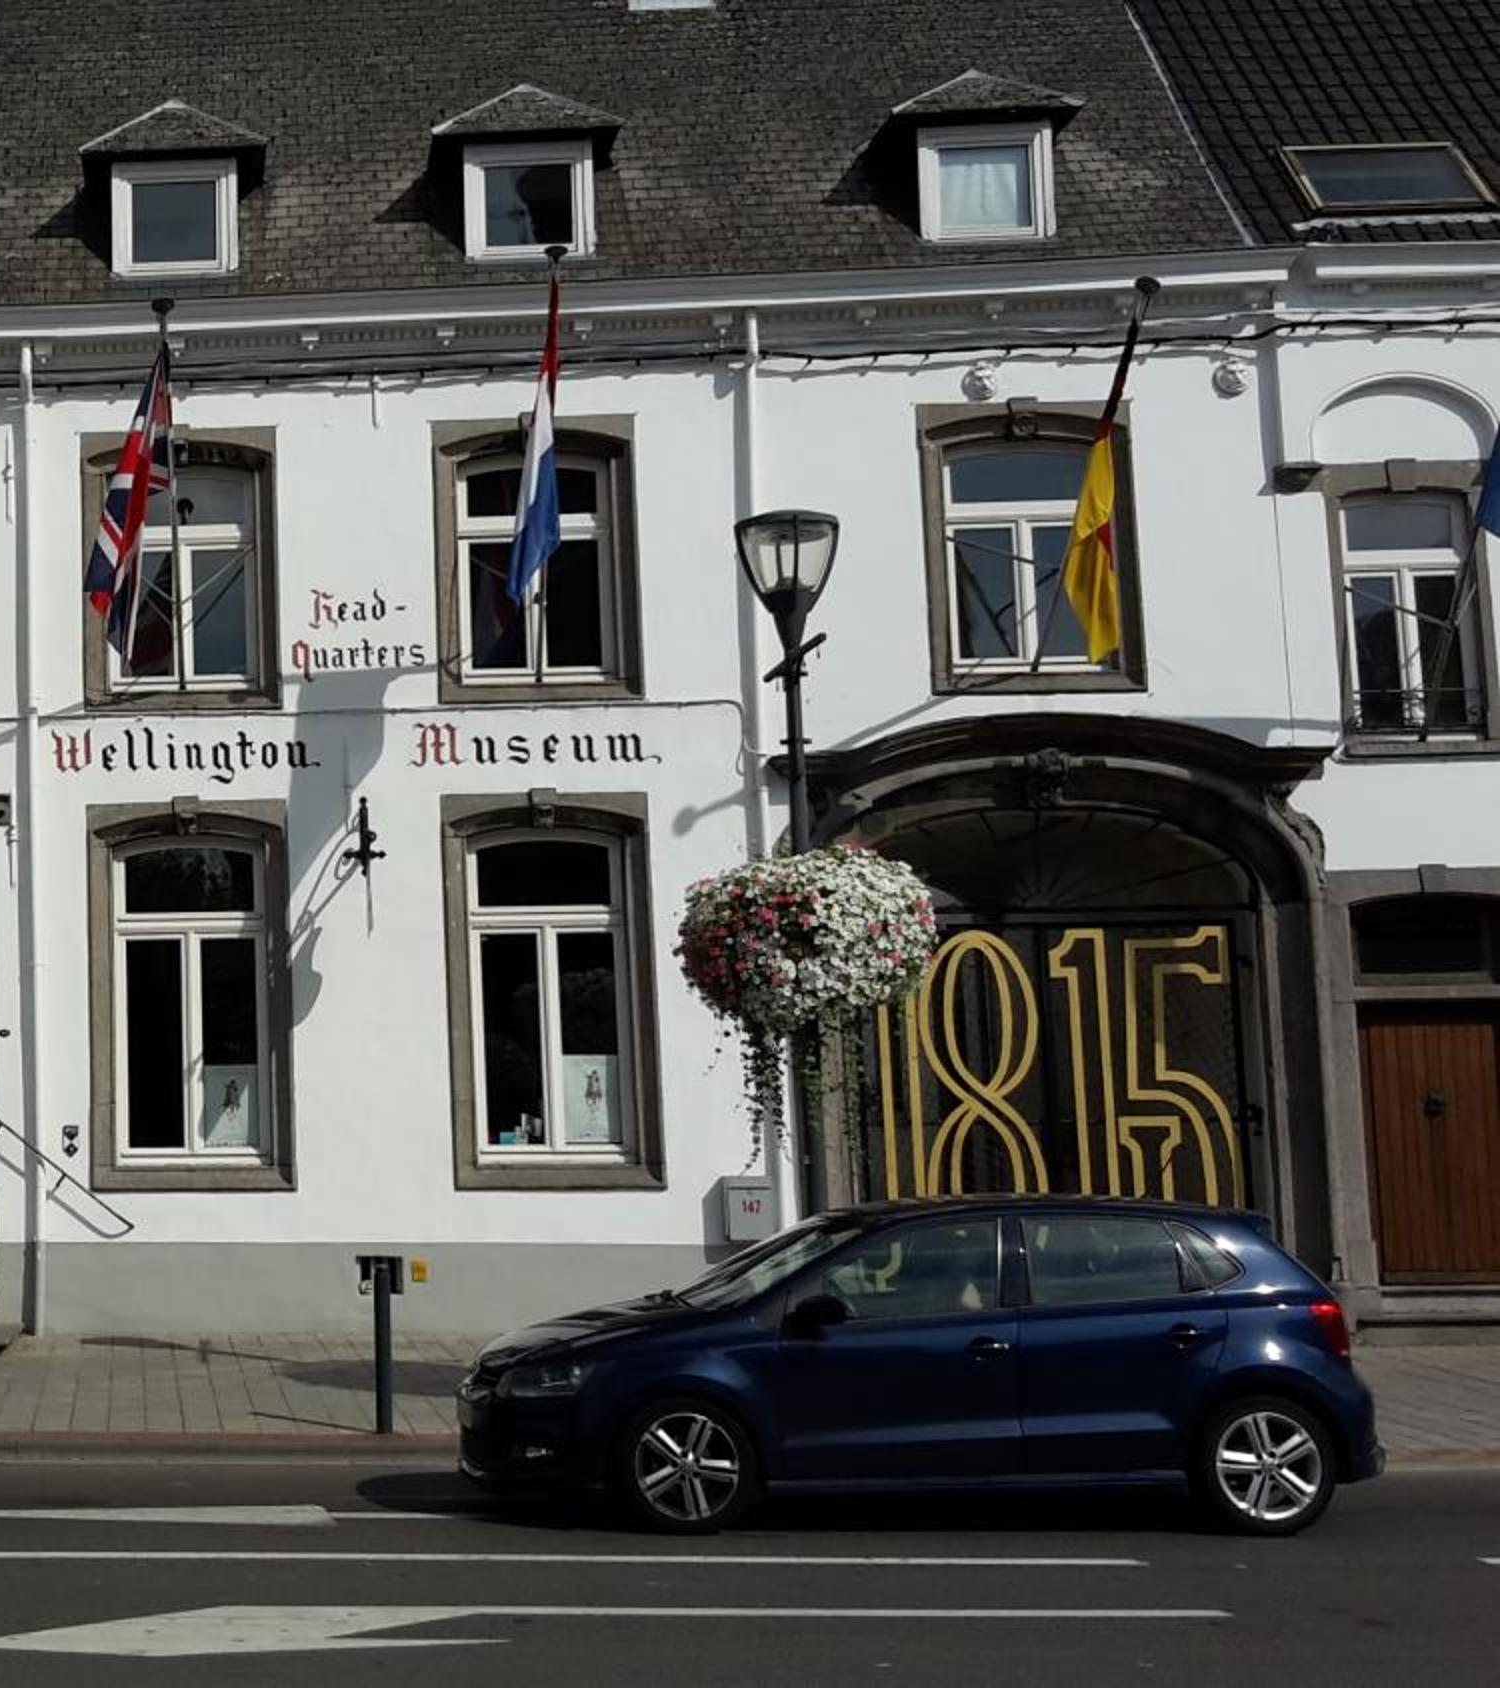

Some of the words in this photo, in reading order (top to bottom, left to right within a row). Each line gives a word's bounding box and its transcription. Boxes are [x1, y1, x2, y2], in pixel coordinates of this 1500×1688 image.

[291, 638, 426, 682] Quarters
[408, 722, 662, 768] Museum
[877, 926, 1245, 1208] 1815
[741, 1199, 761, 1214] 147
